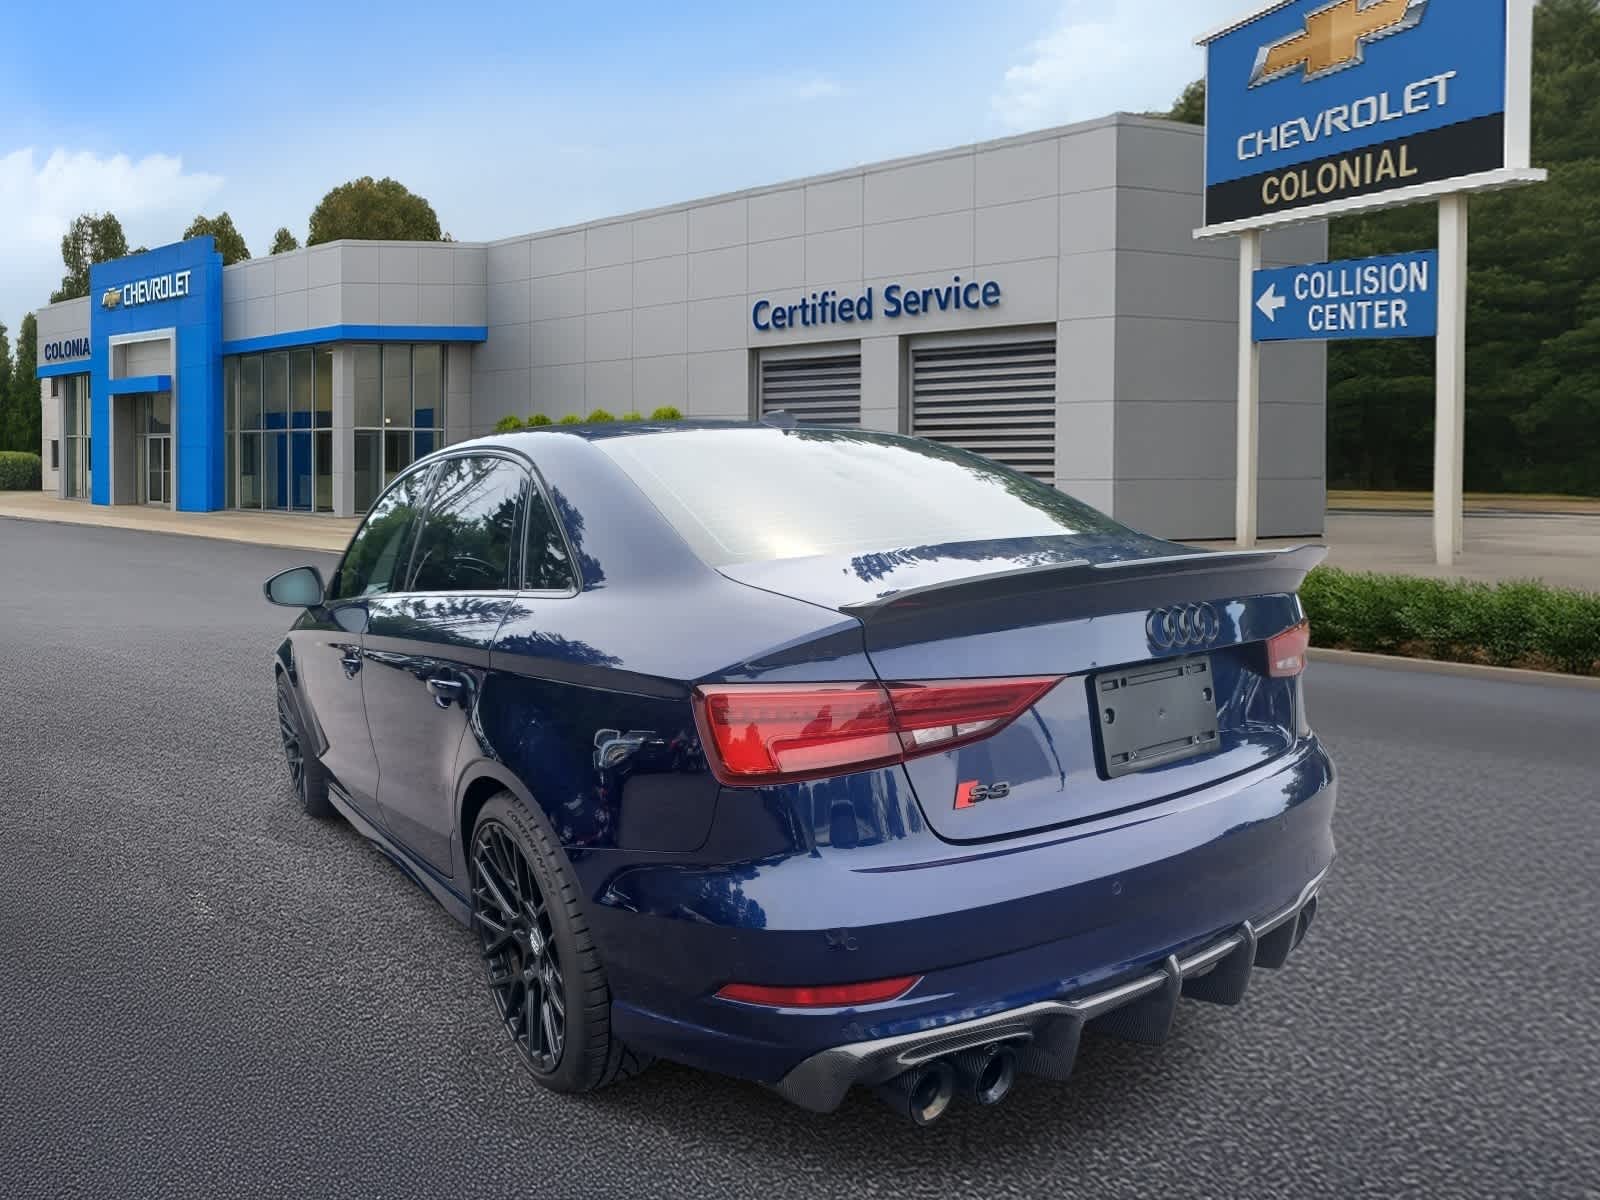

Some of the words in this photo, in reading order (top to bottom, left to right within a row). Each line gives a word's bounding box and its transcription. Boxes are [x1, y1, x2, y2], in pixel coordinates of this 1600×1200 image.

[1237, 70, 1457, 160] CHEVROLET
[1261, 145, 1418, 205] COLONIAL
[123, 271, 191, 305] CHEVROLET
[752, 287, 873, 331] Certified
[883, 275, 1001, 318] Service
[1294, 261, 1428, 300] COLLISION
[1308, 299, 1408, 331] CENTER
